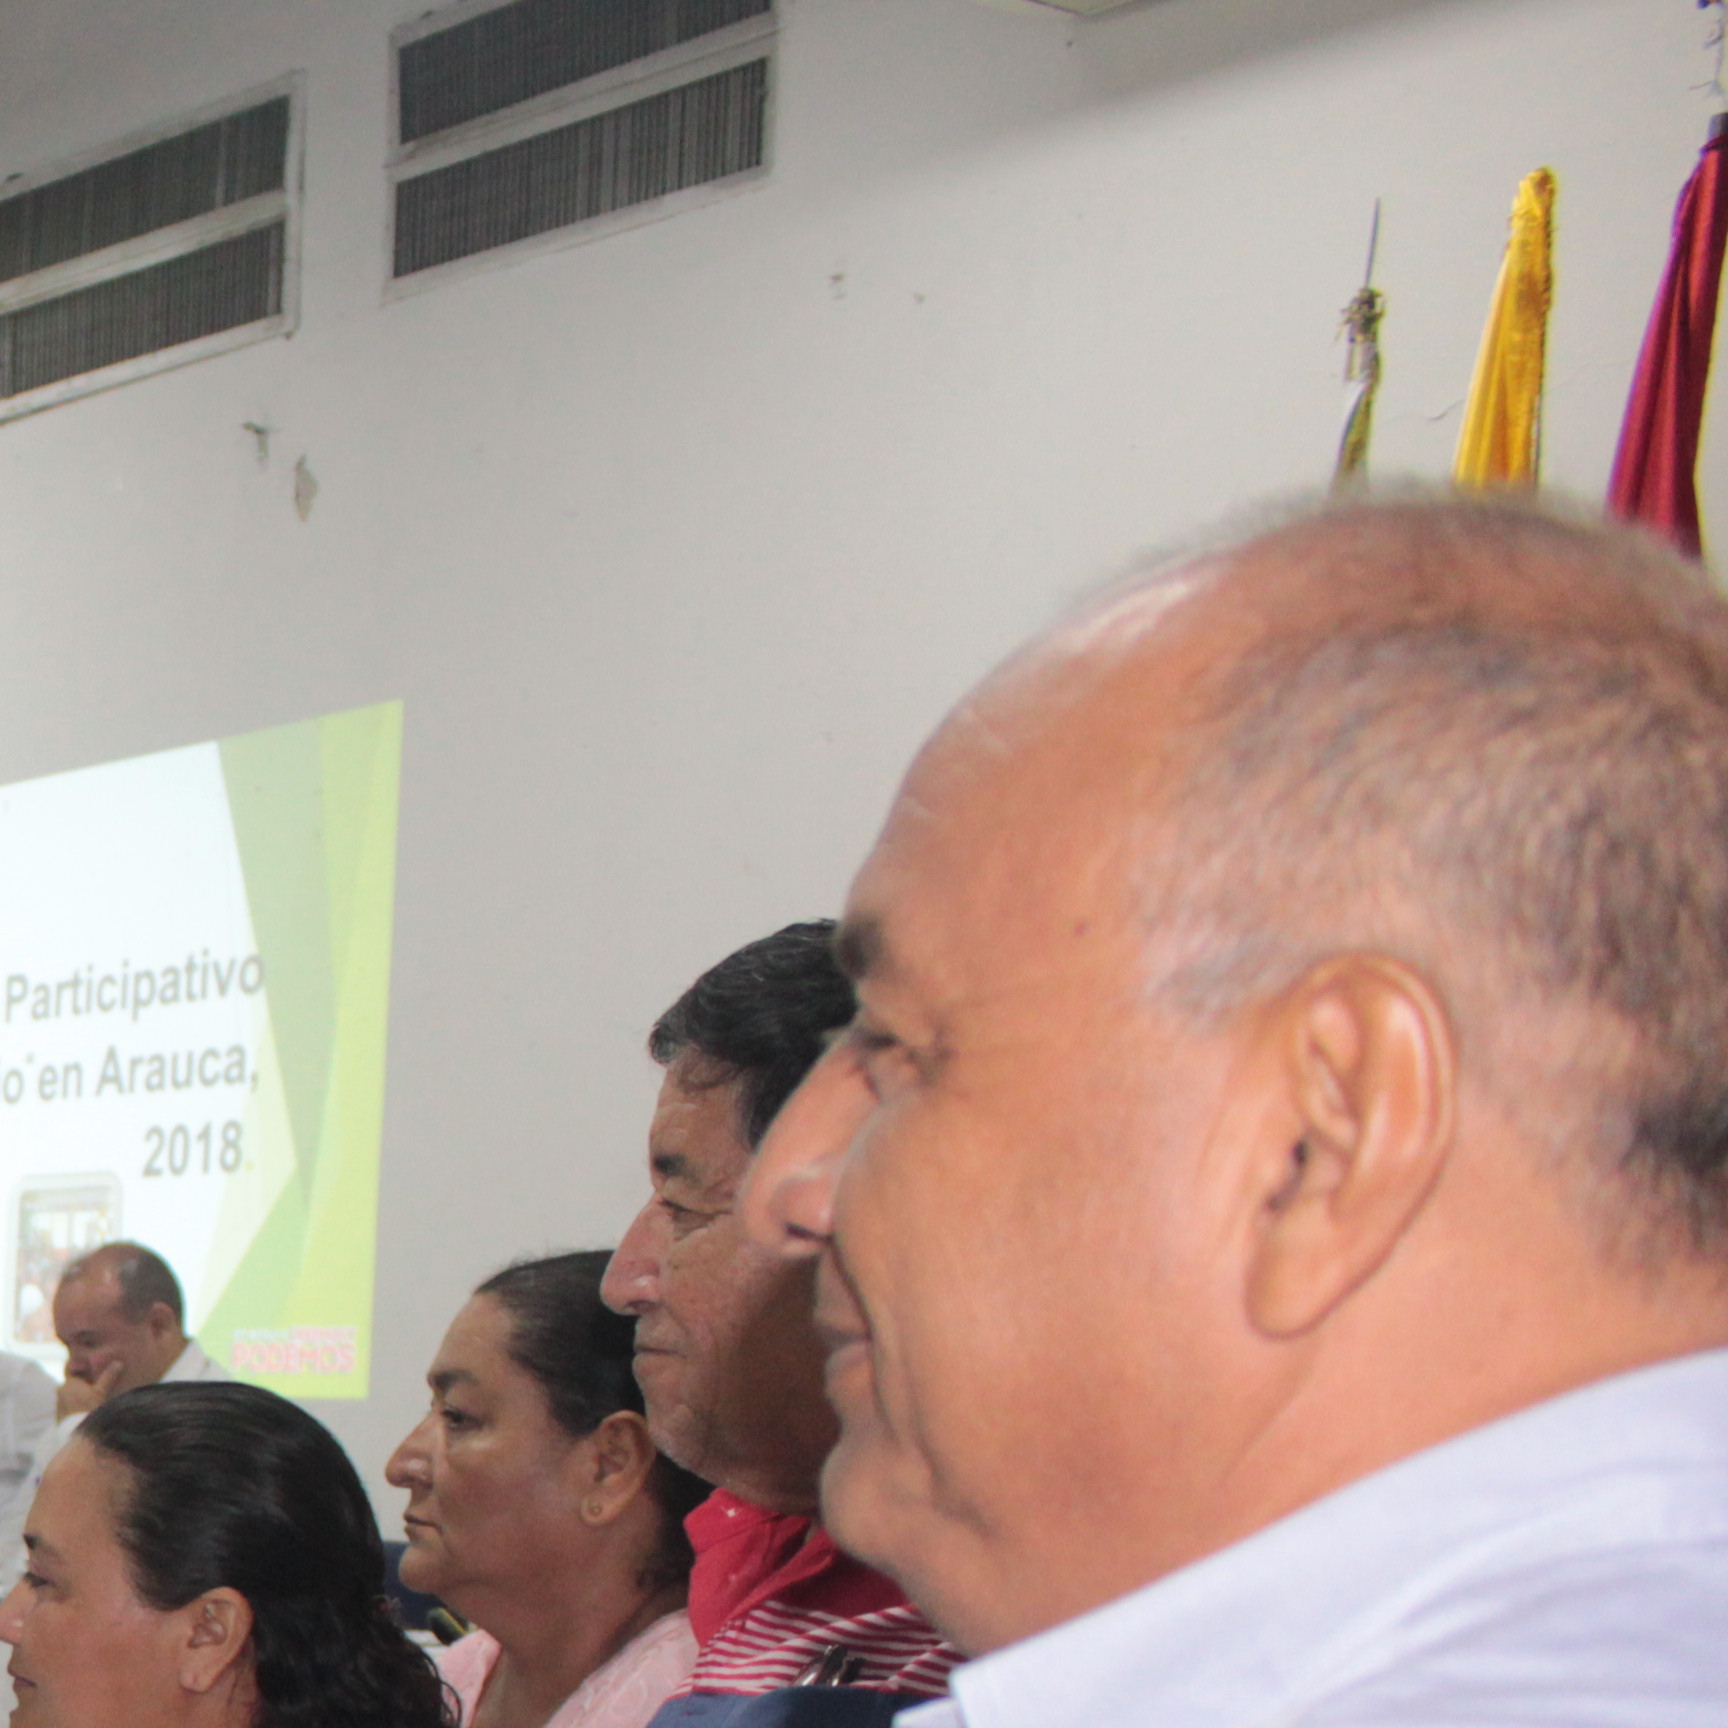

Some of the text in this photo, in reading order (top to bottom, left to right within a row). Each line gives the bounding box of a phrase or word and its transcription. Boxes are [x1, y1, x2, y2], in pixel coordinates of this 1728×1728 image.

[4, 949, 265, 1022] Participativo
[37, 1058, 83, 1102] en
[95, 1043, 259, 1097] Arauca,
